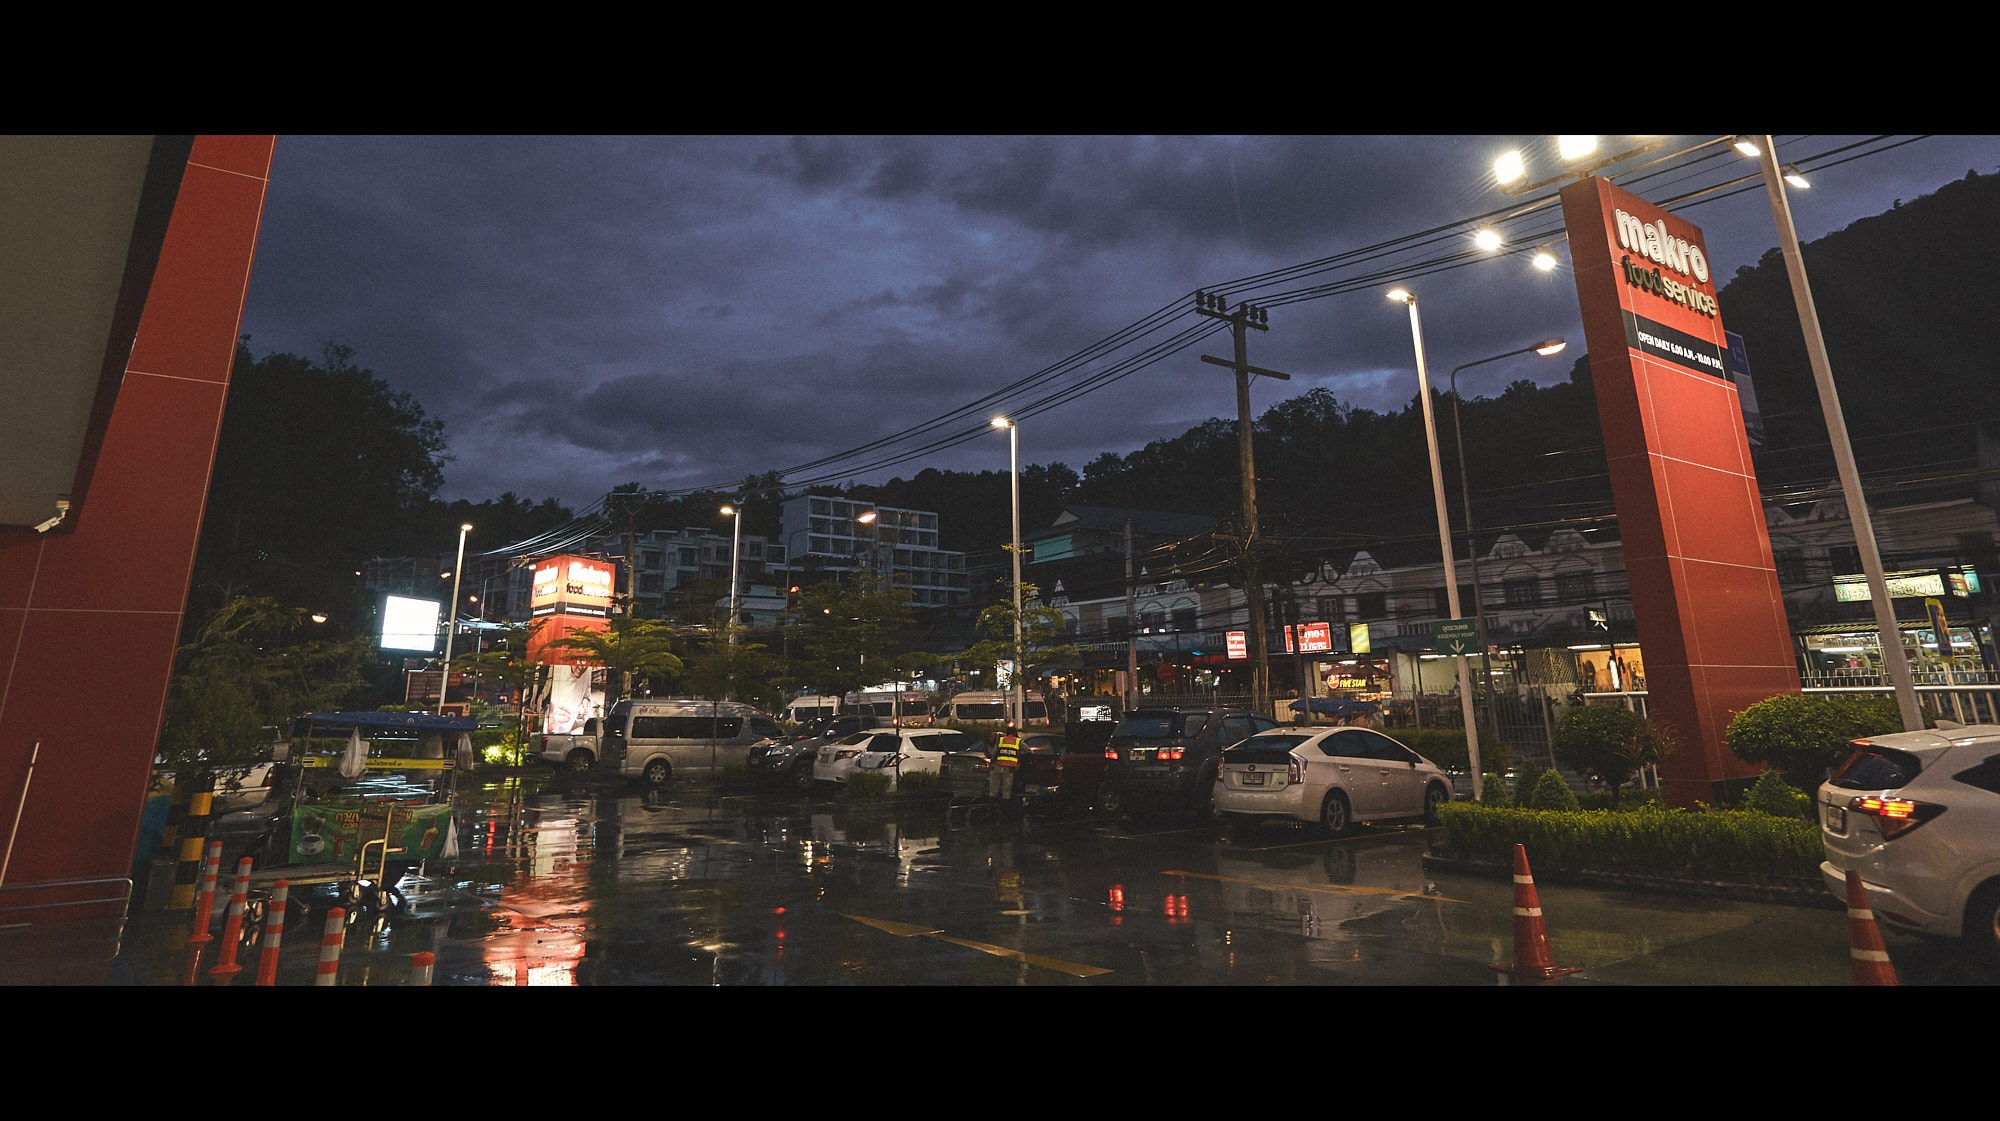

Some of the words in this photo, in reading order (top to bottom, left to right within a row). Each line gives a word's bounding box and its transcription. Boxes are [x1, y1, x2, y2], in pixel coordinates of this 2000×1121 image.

[1614, 208, 1709, 283] makro
[1638, 331, 1655, 346] OPEN
[1654, 336, 1671, 352] DAILY
[1340, 679, 1351, 688] FIVE
[1352, 678, 1366, 687] STAR
